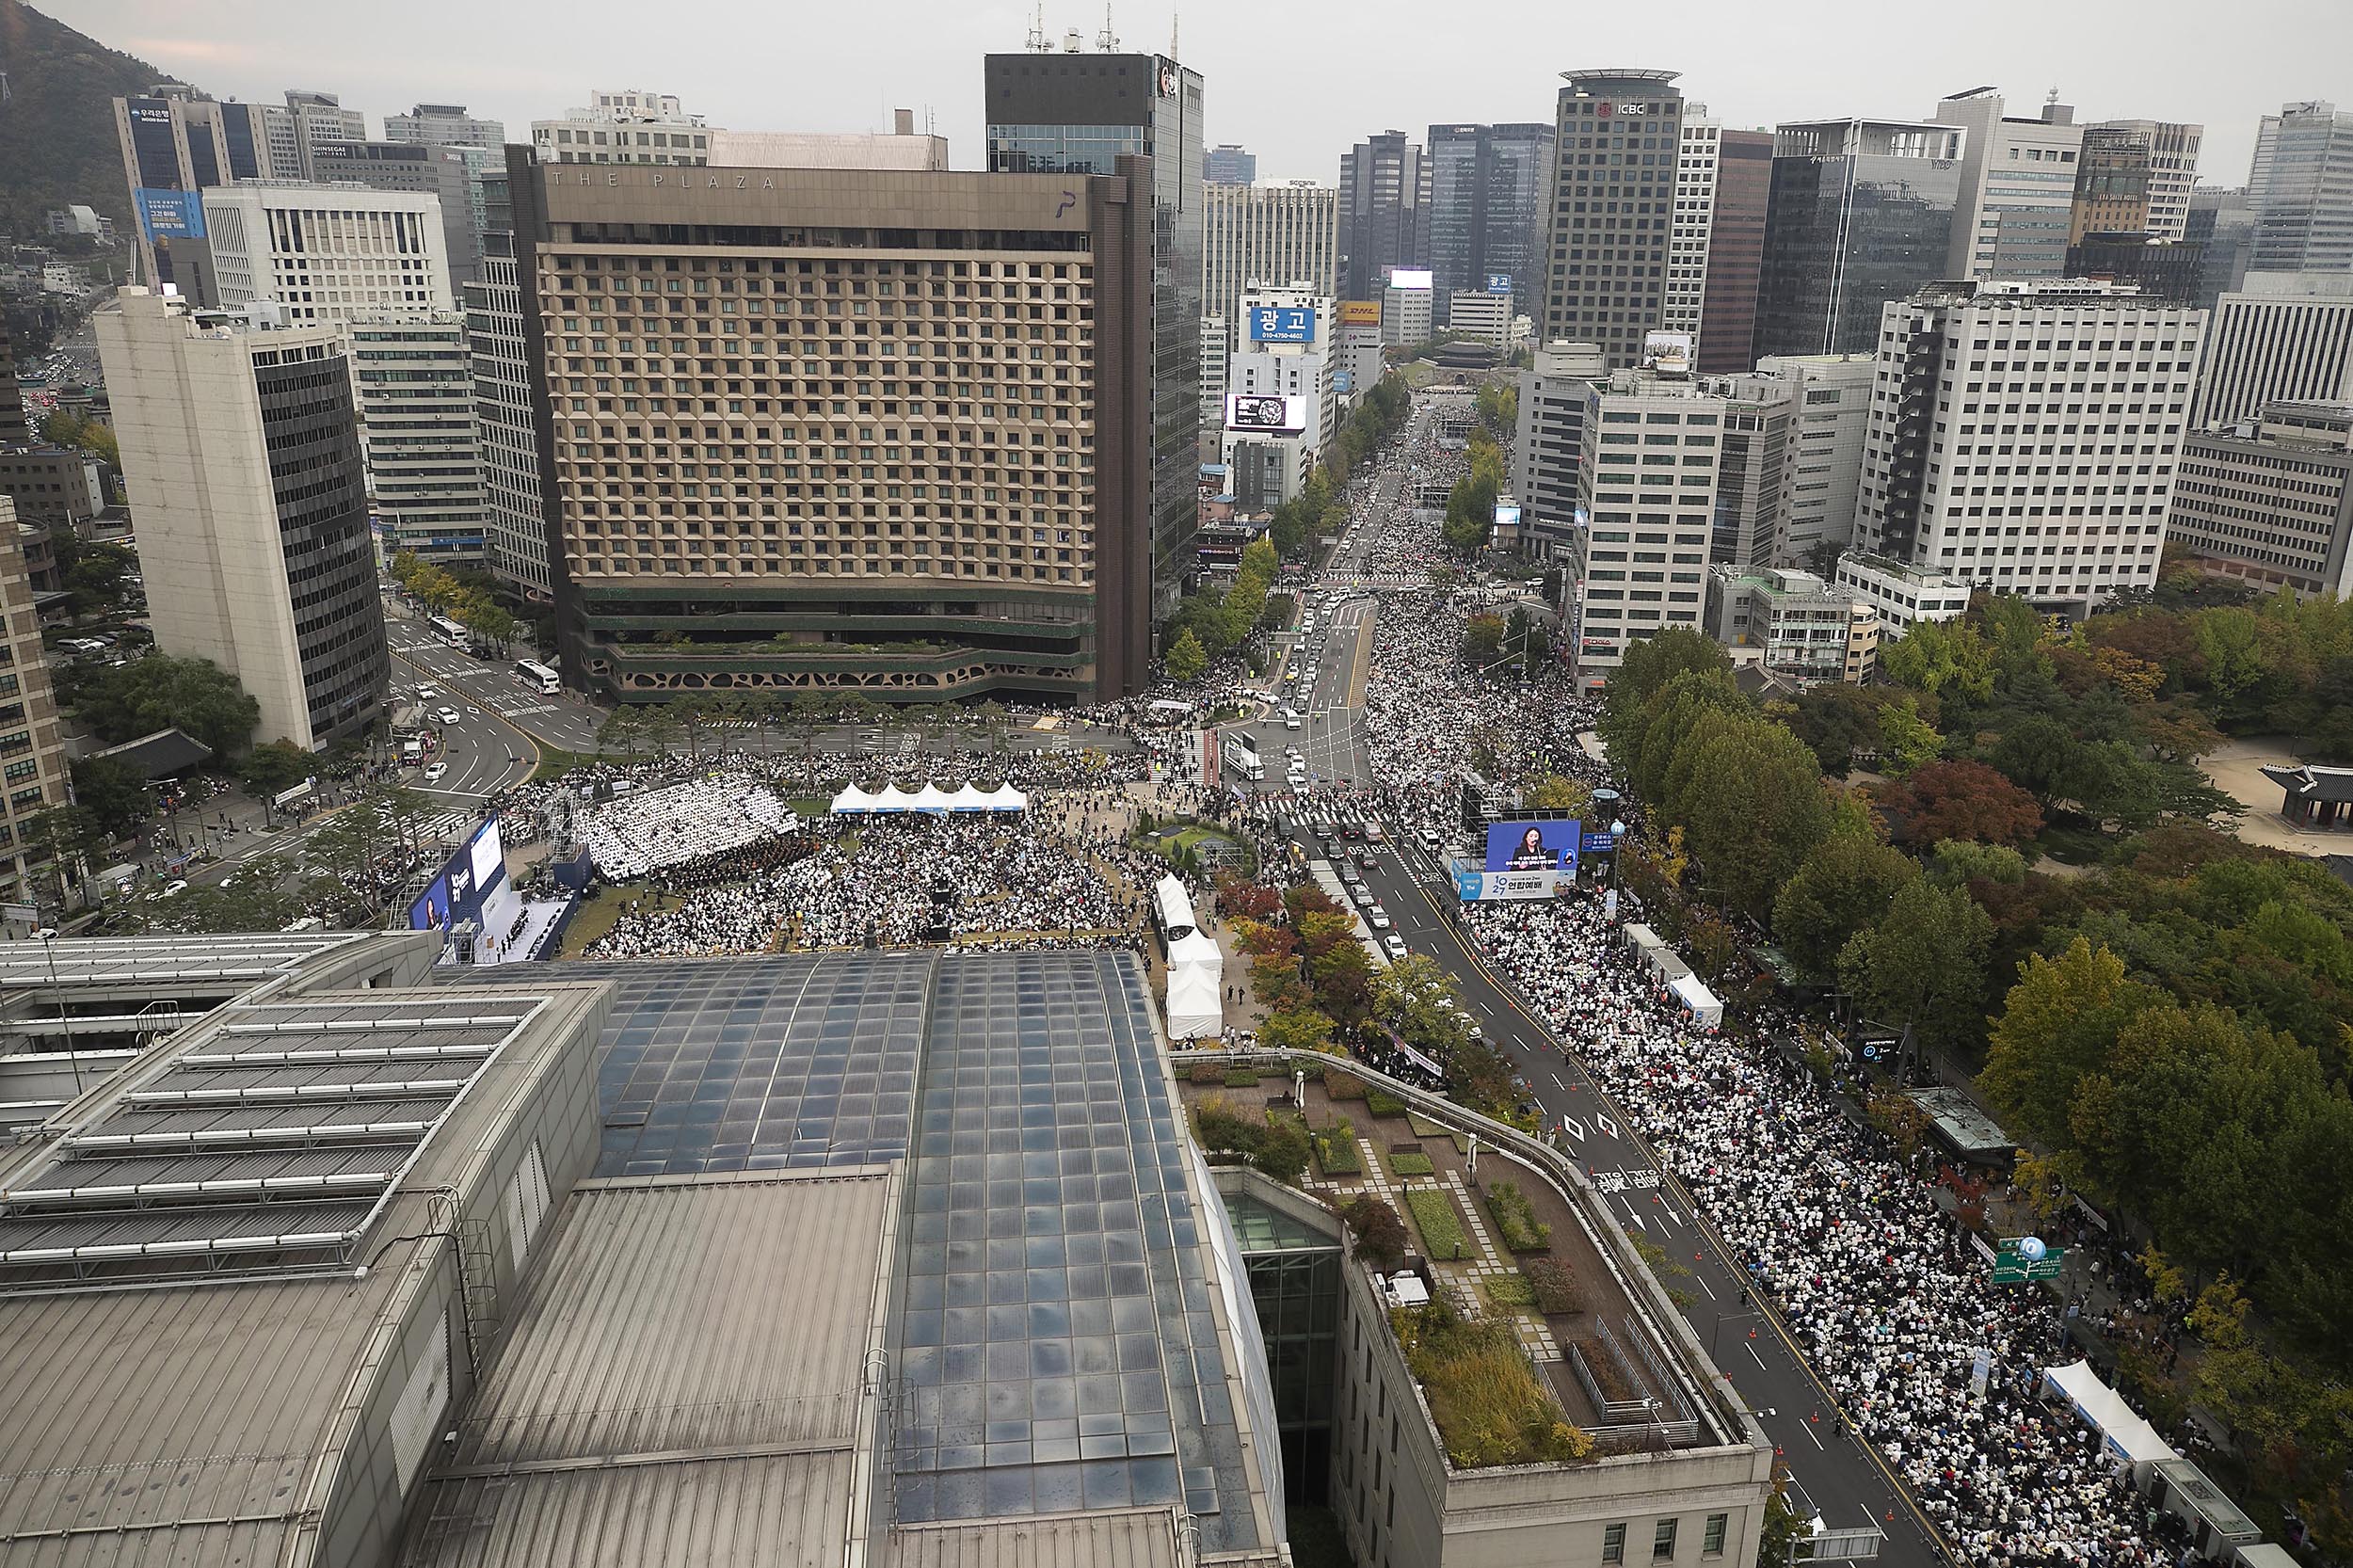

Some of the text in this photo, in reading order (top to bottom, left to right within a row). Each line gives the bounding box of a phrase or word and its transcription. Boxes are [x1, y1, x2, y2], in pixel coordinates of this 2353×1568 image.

[141, 109, 169, 118] 우리은행
[1618, 104, 1645, 115] ICBC
[552, 173, 775, 189] THE PLAZA
[1370, 844, 1389, 855] 50
[1496, 875, 1508, 886] 10
[1508, 881, 1543, 890] 연합예배
[1492, 885, 1506, 895] 27
